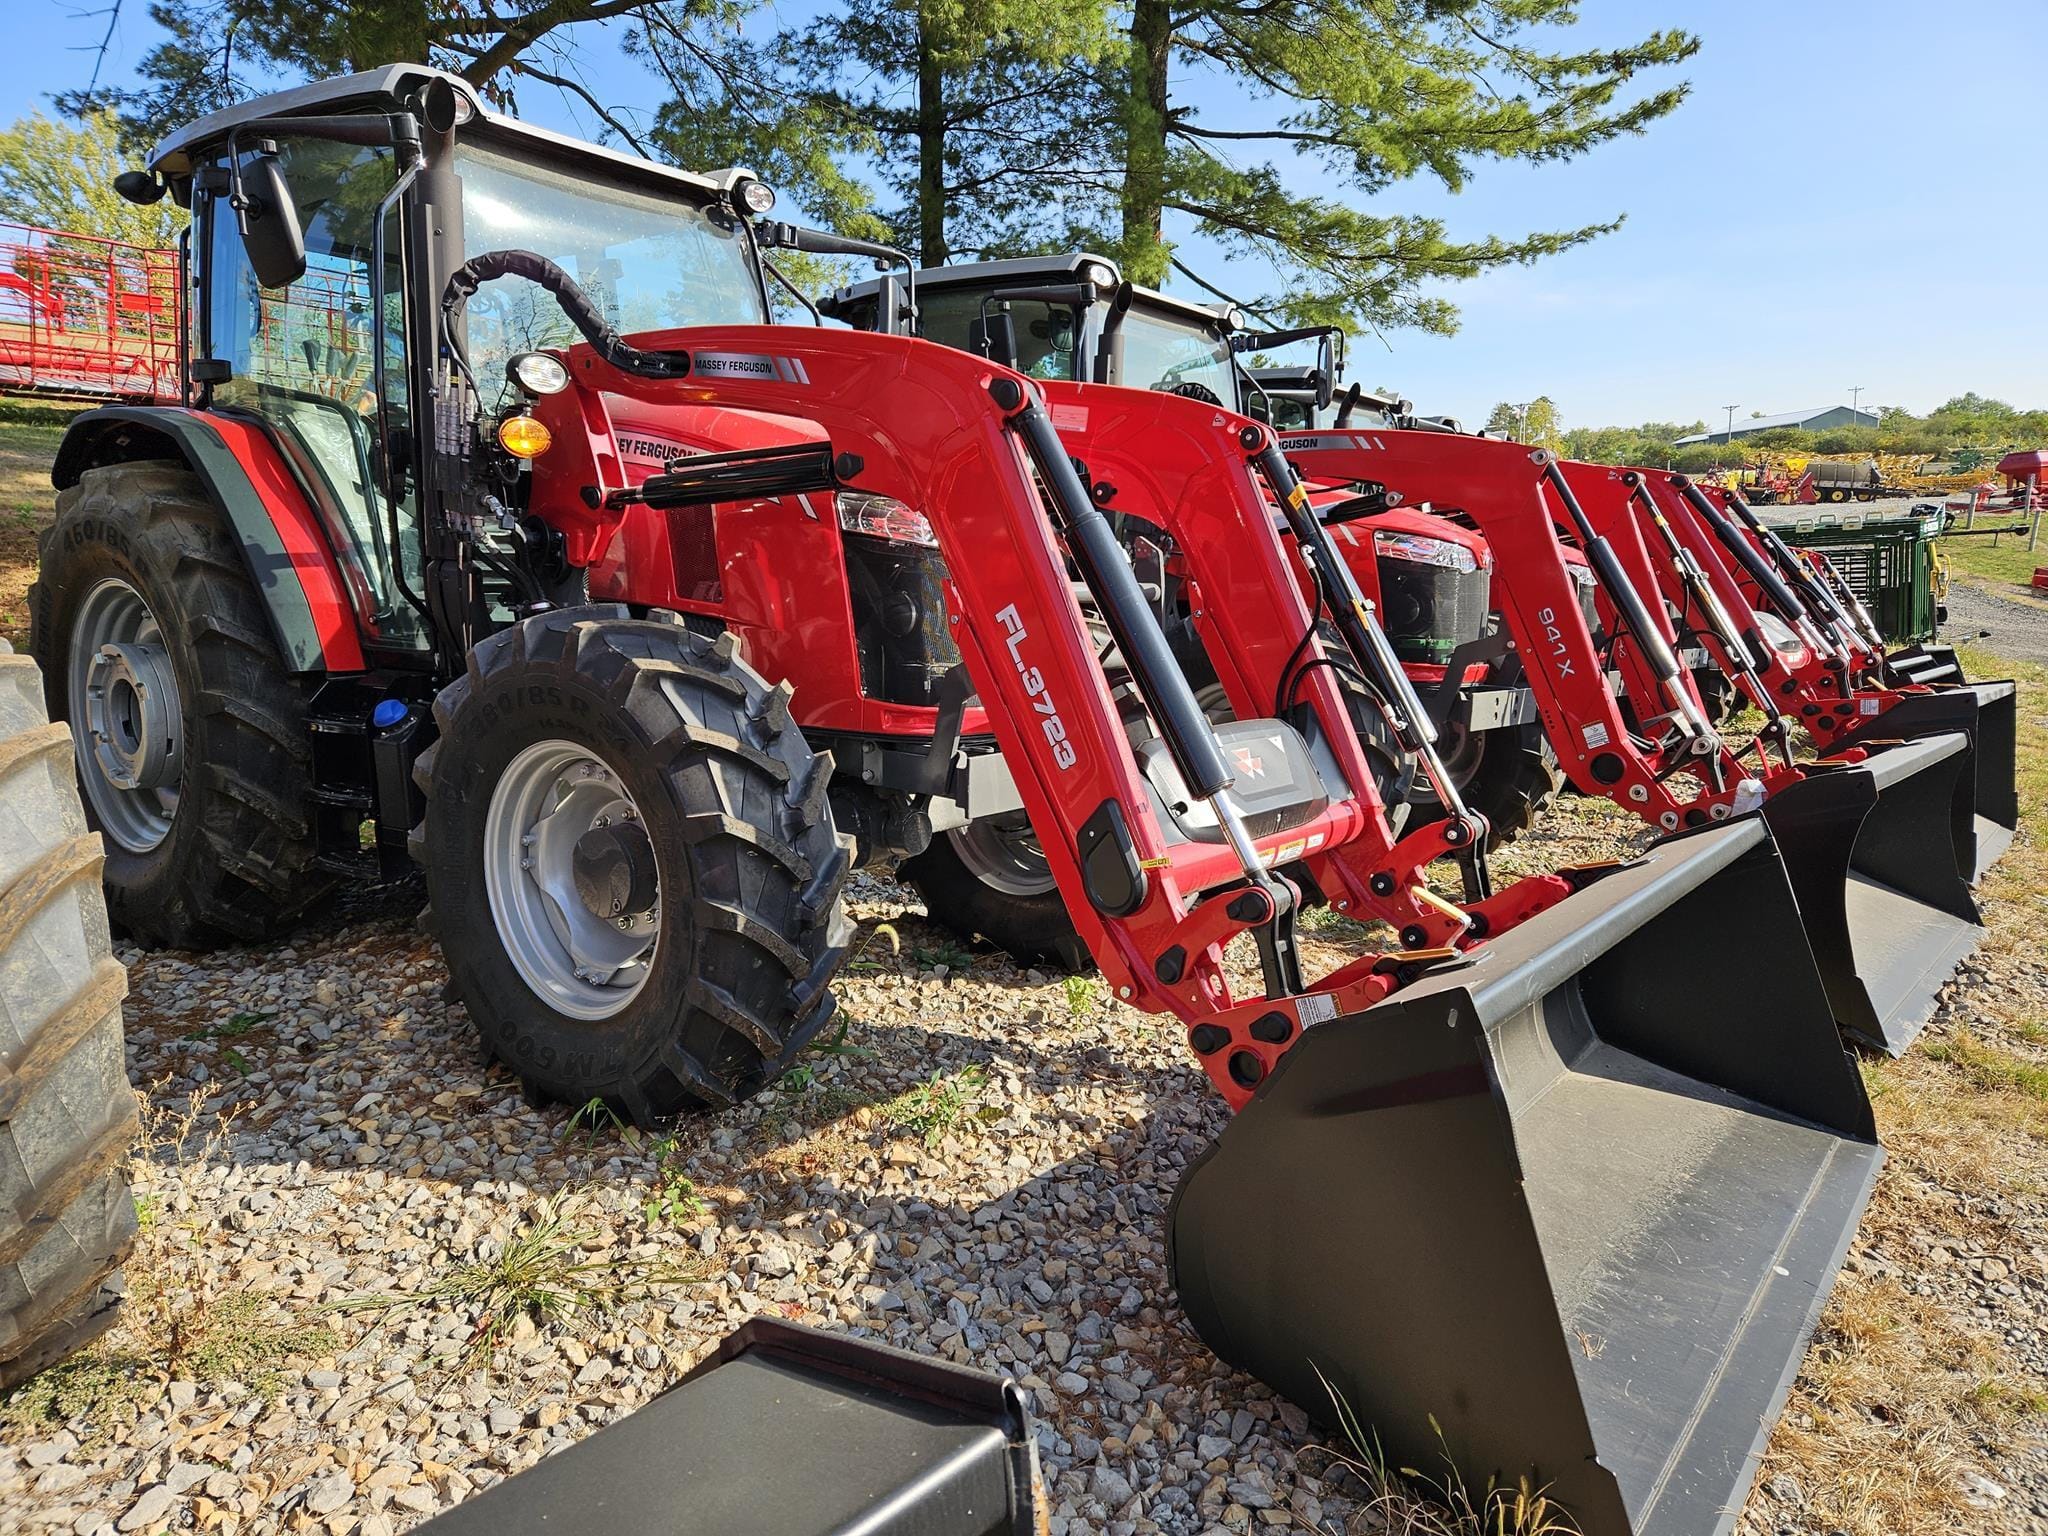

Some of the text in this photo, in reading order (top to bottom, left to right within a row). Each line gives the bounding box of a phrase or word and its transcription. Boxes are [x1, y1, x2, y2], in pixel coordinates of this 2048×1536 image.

[695, 359, 772, 374] MASSEY FERGUSON
[995, 603, 1077, 770] FL.3723
